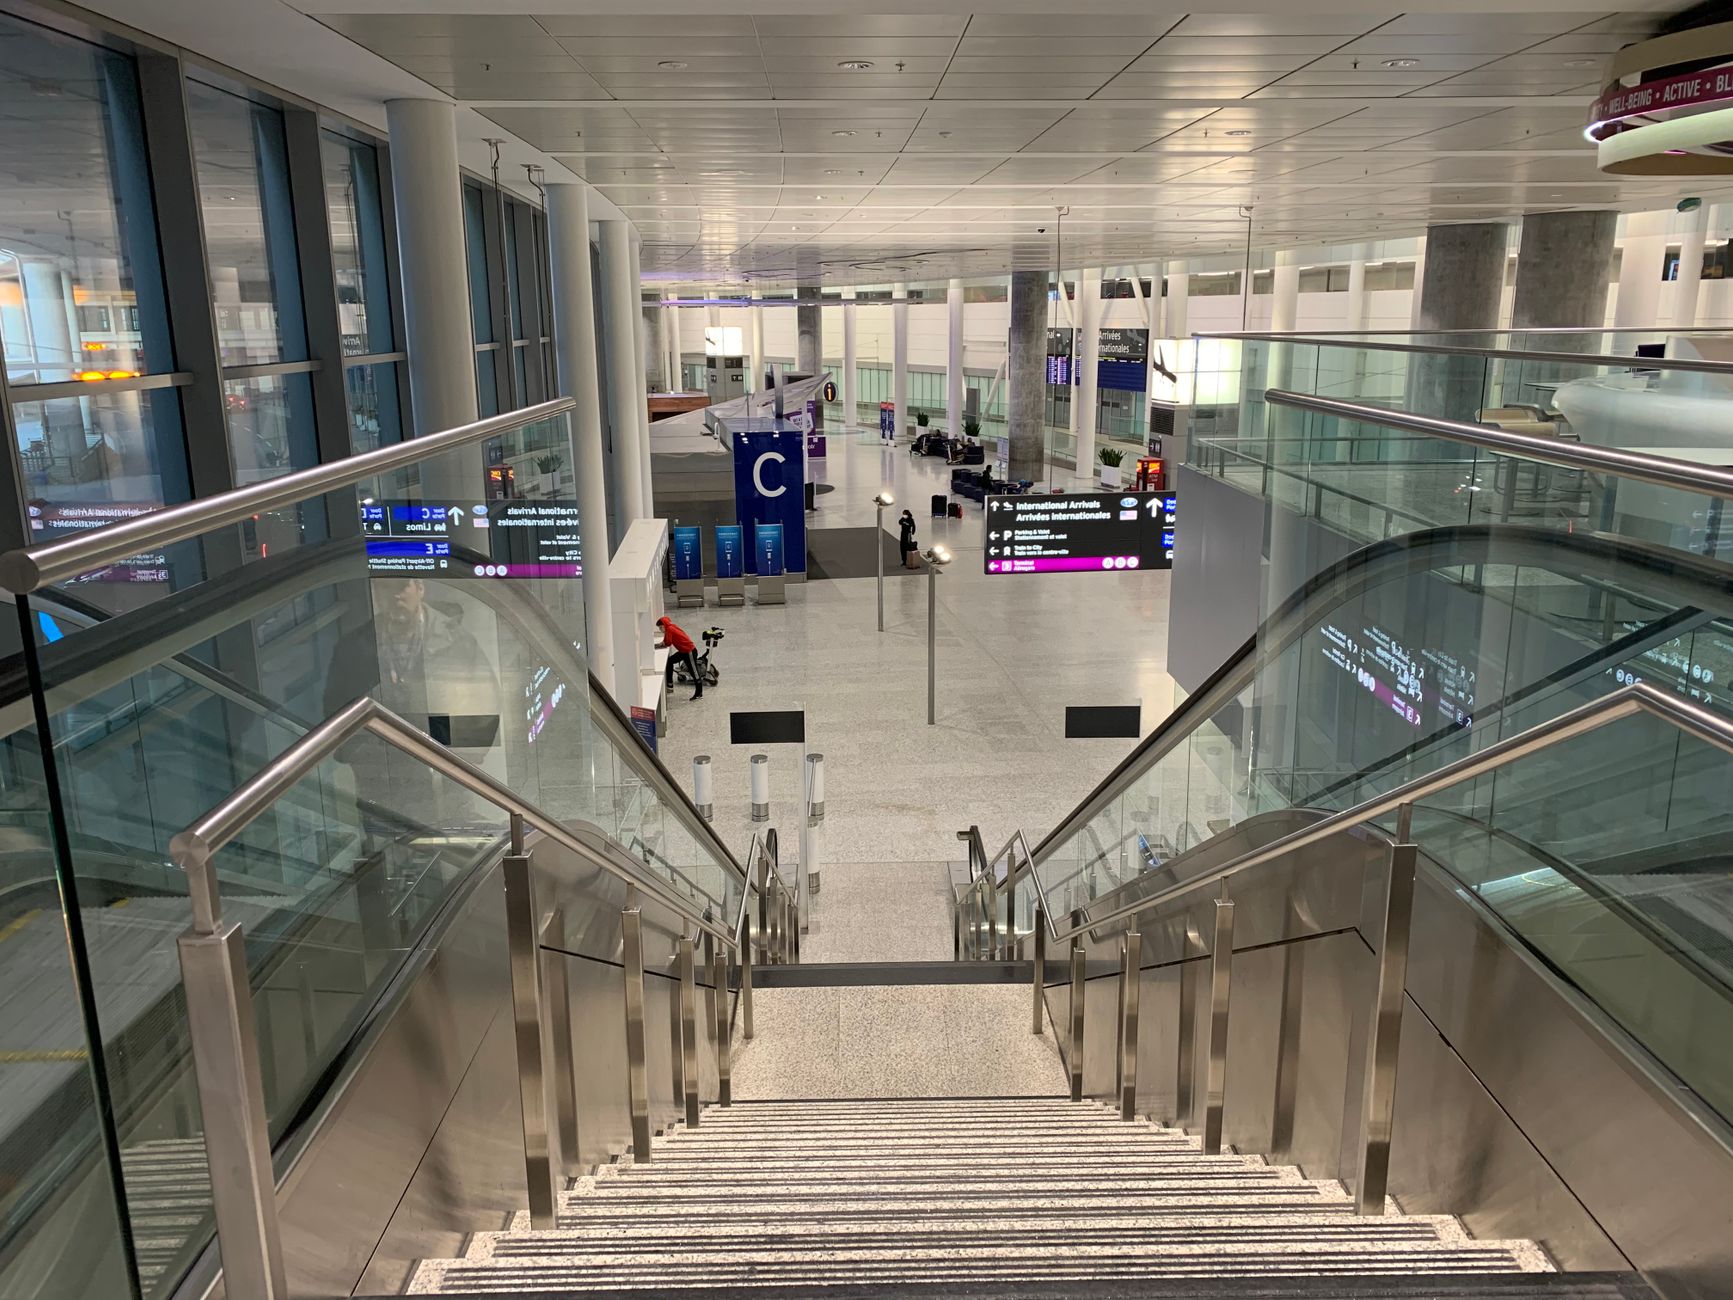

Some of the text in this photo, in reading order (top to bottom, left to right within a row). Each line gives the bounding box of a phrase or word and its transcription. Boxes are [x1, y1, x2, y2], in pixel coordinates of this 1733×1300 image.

[1609, 89, 1653, 114] WELL-BEING
[1663, 79, 1701, 102] ACTIVE
[753, 451, 787, 498] C
[1016, 499, 1101, 511] International Arrivals
[1016, 510, 1111, 522] Arrivées internationales
